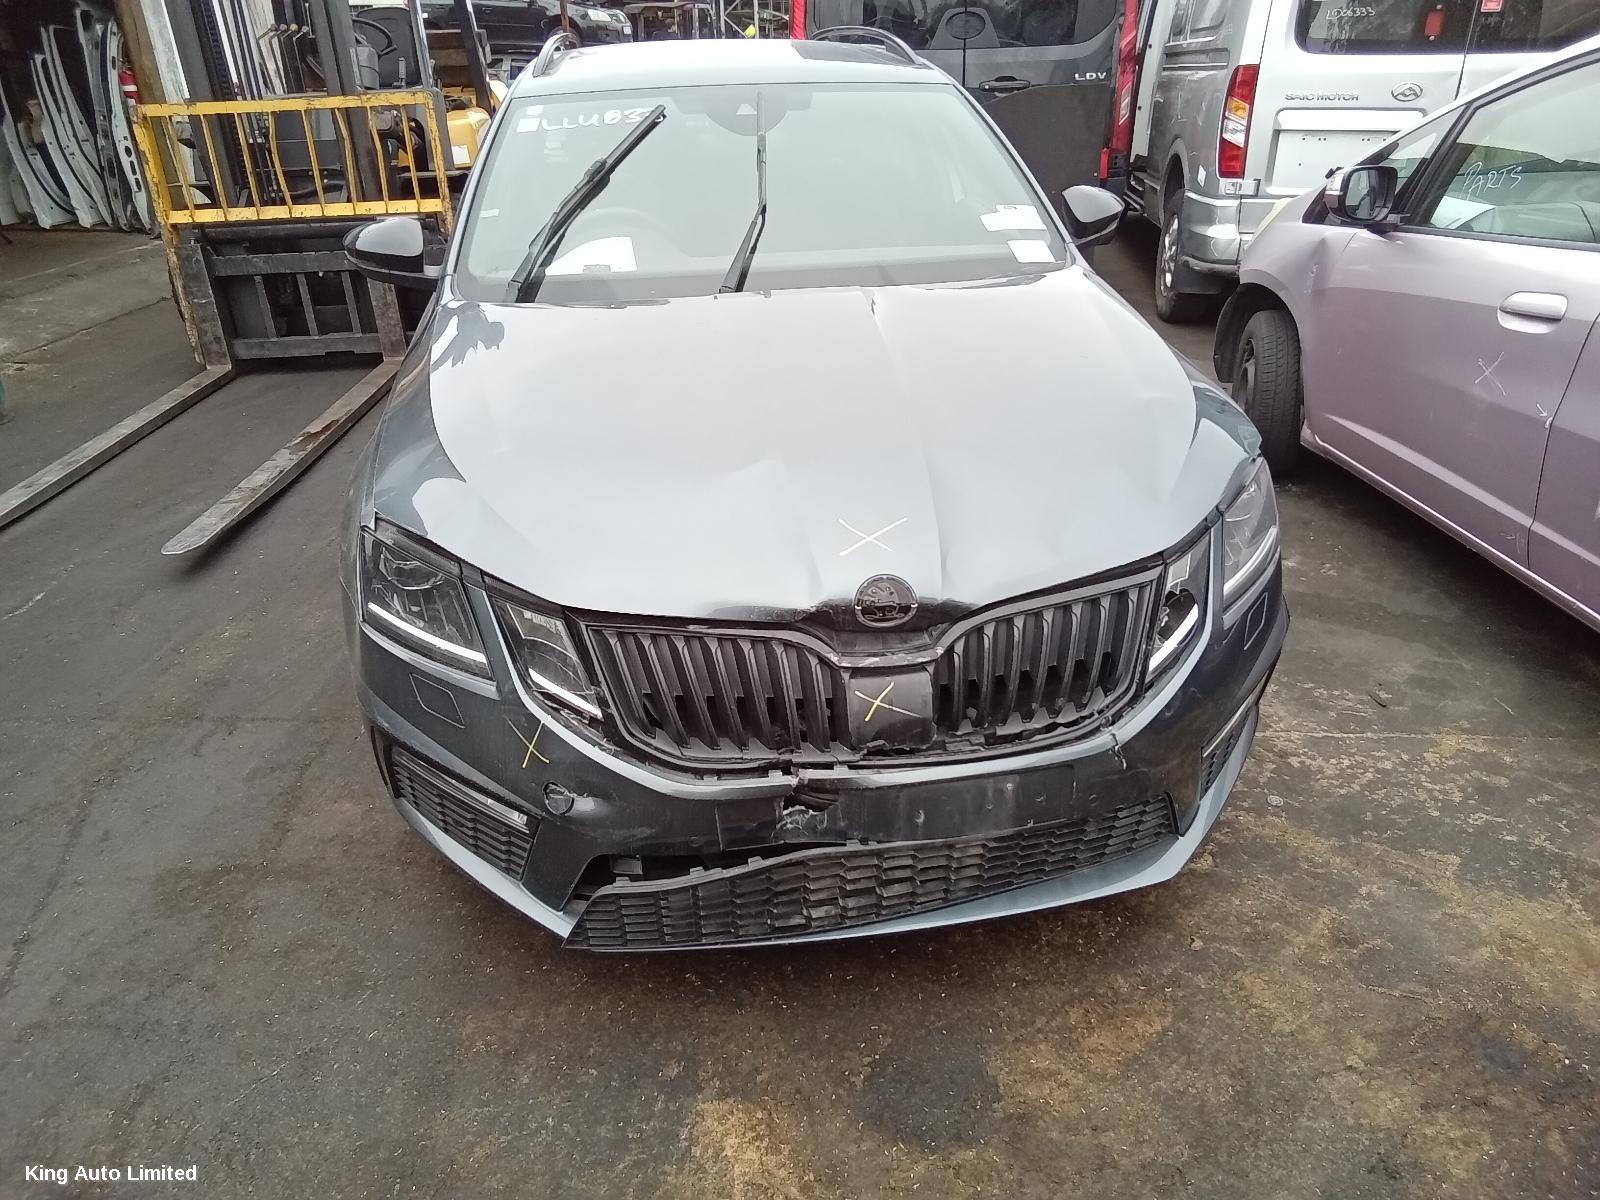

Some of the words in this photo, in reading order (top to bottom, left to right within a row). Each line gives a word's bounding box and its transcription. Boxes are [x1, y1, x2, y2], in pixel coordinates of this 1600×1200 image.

[1074, 71, 1107, 80] LDV
[1284, 93, 1315, 101] SAIC
[1317, 93, 1359, 101] MOTOR
[1461, 161, 1523, 201] PARTS
